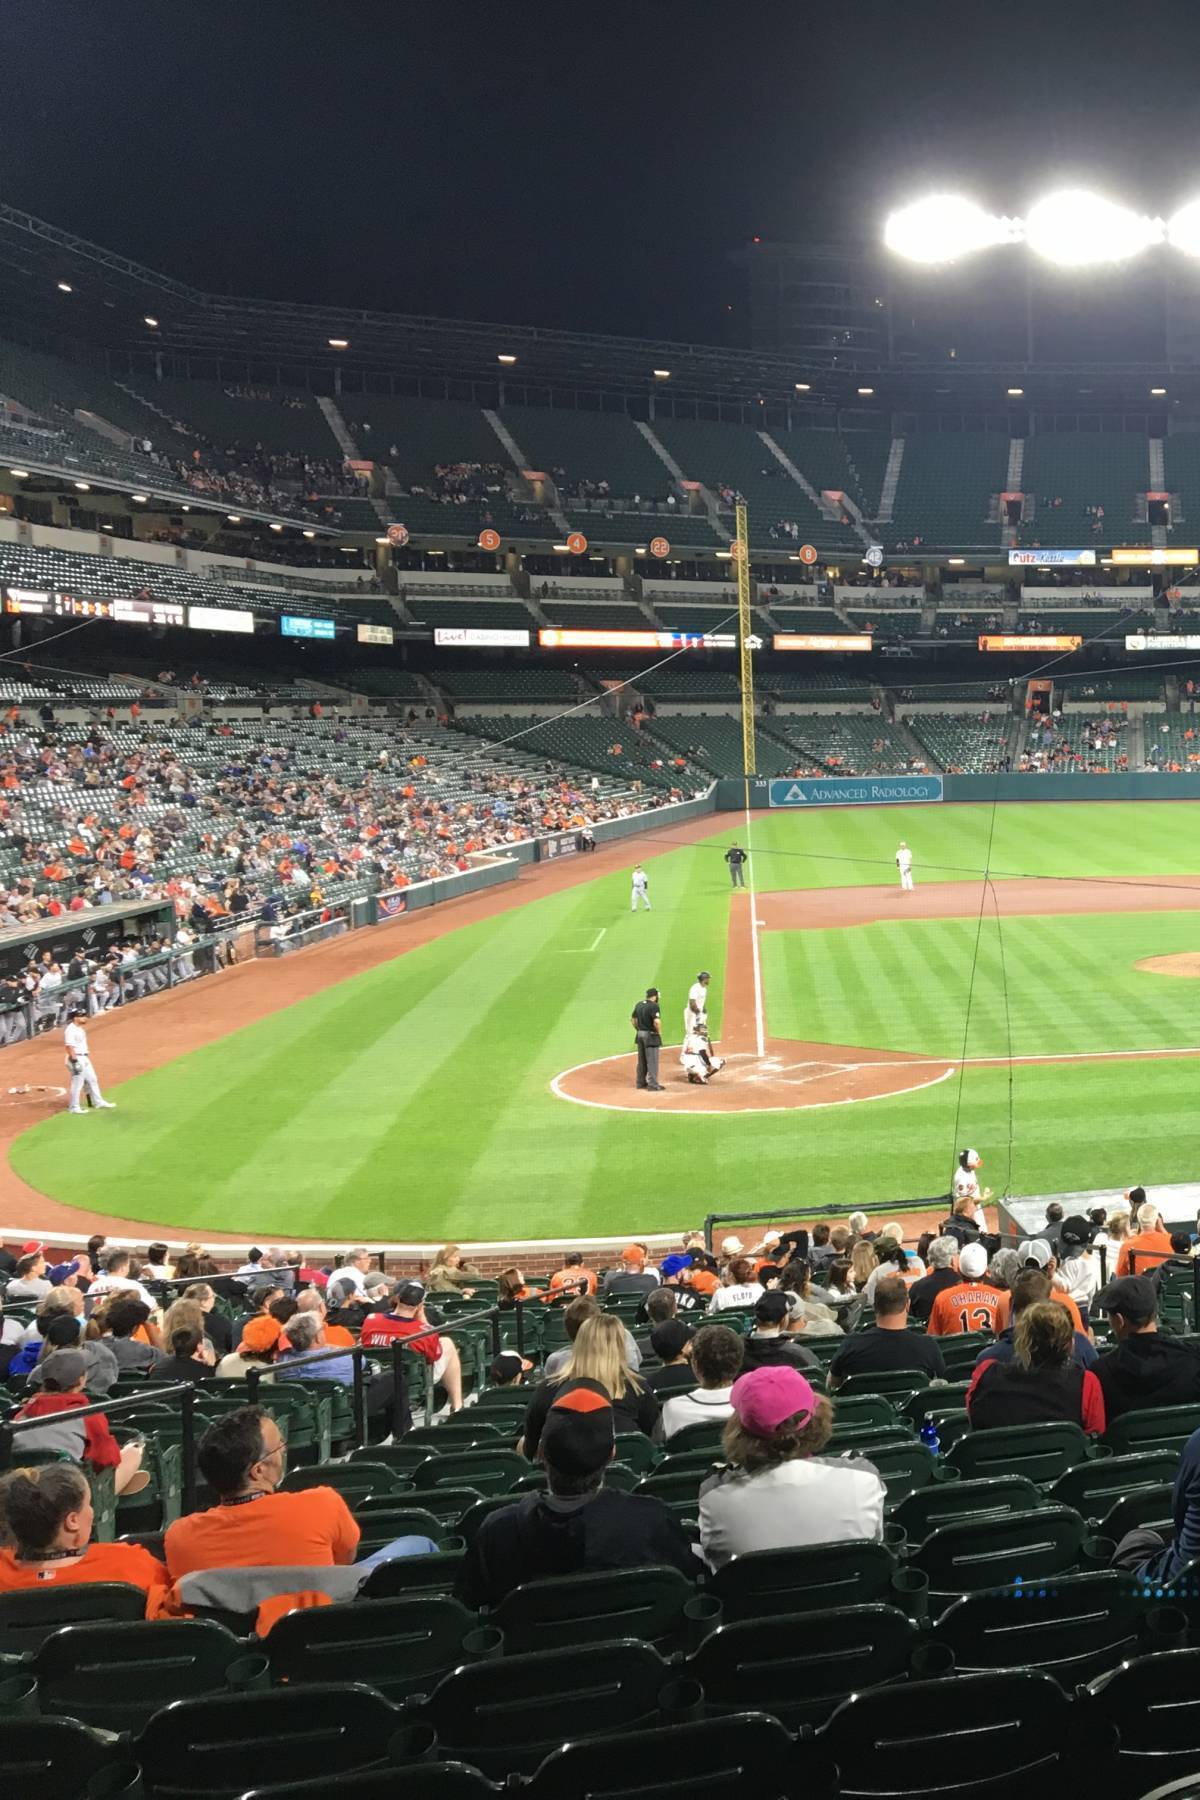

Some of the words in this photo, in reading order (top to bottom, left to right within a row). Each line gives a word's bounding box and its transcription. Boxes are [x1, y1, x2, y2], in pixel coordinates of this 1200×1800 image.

[653, 541, 668, 553] 22
[868, 551, 881, 562] 42
[437, 630, 467, 641] Live!
[732, 1291, 753, 1302] FLOYD
[959, 1307, 992, 1333] 13
